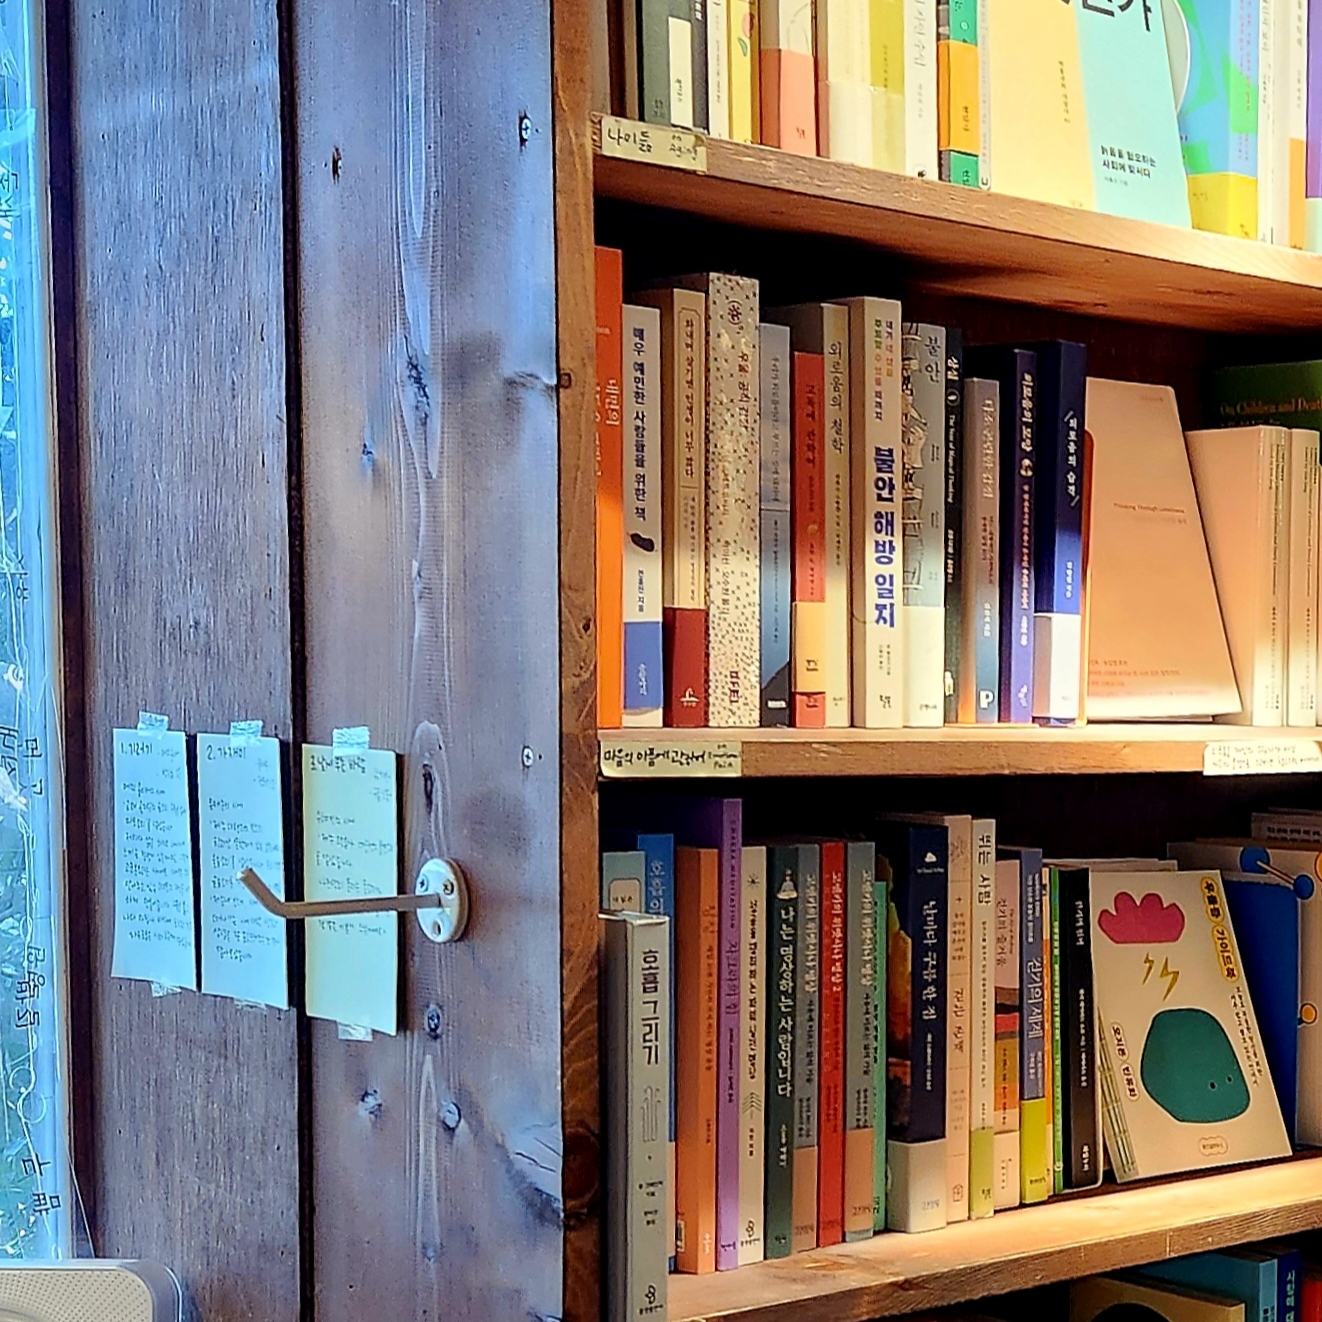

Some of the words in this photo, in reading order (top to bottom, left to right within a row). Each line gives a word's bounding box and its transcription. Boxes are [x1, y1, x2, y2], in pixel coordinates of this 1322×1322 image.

[634, 361, 645, 405] 예민한
[1236, 401, 1275, 416] Children
[1276, 399, 1295, 413] and
[634, 411, 645, 468] 사람들을
[874, 511, 896, 566] 해방
[874, 574, 896, 628] 일지
[977, 834, 992, 865] 뛰는
[977, 874, 991, 905] 사람
[779, 907, 795, 941] 나는
[921, 900, 937, 946] 날마다
[641, 949, 660, 994] 호흡
[778, 945, 794, 1013] 명상하는
[922, 951, 937, 982] 구름
[1027, 957, 1042, 1004] 걷기의
[922, 986, 936, 1000] 한
[641, 1001, 661, 1065] 그리기
[1027, 1006, 1042, 1039] 세계
[777, 1015, 791, 1098] 사람입니다
